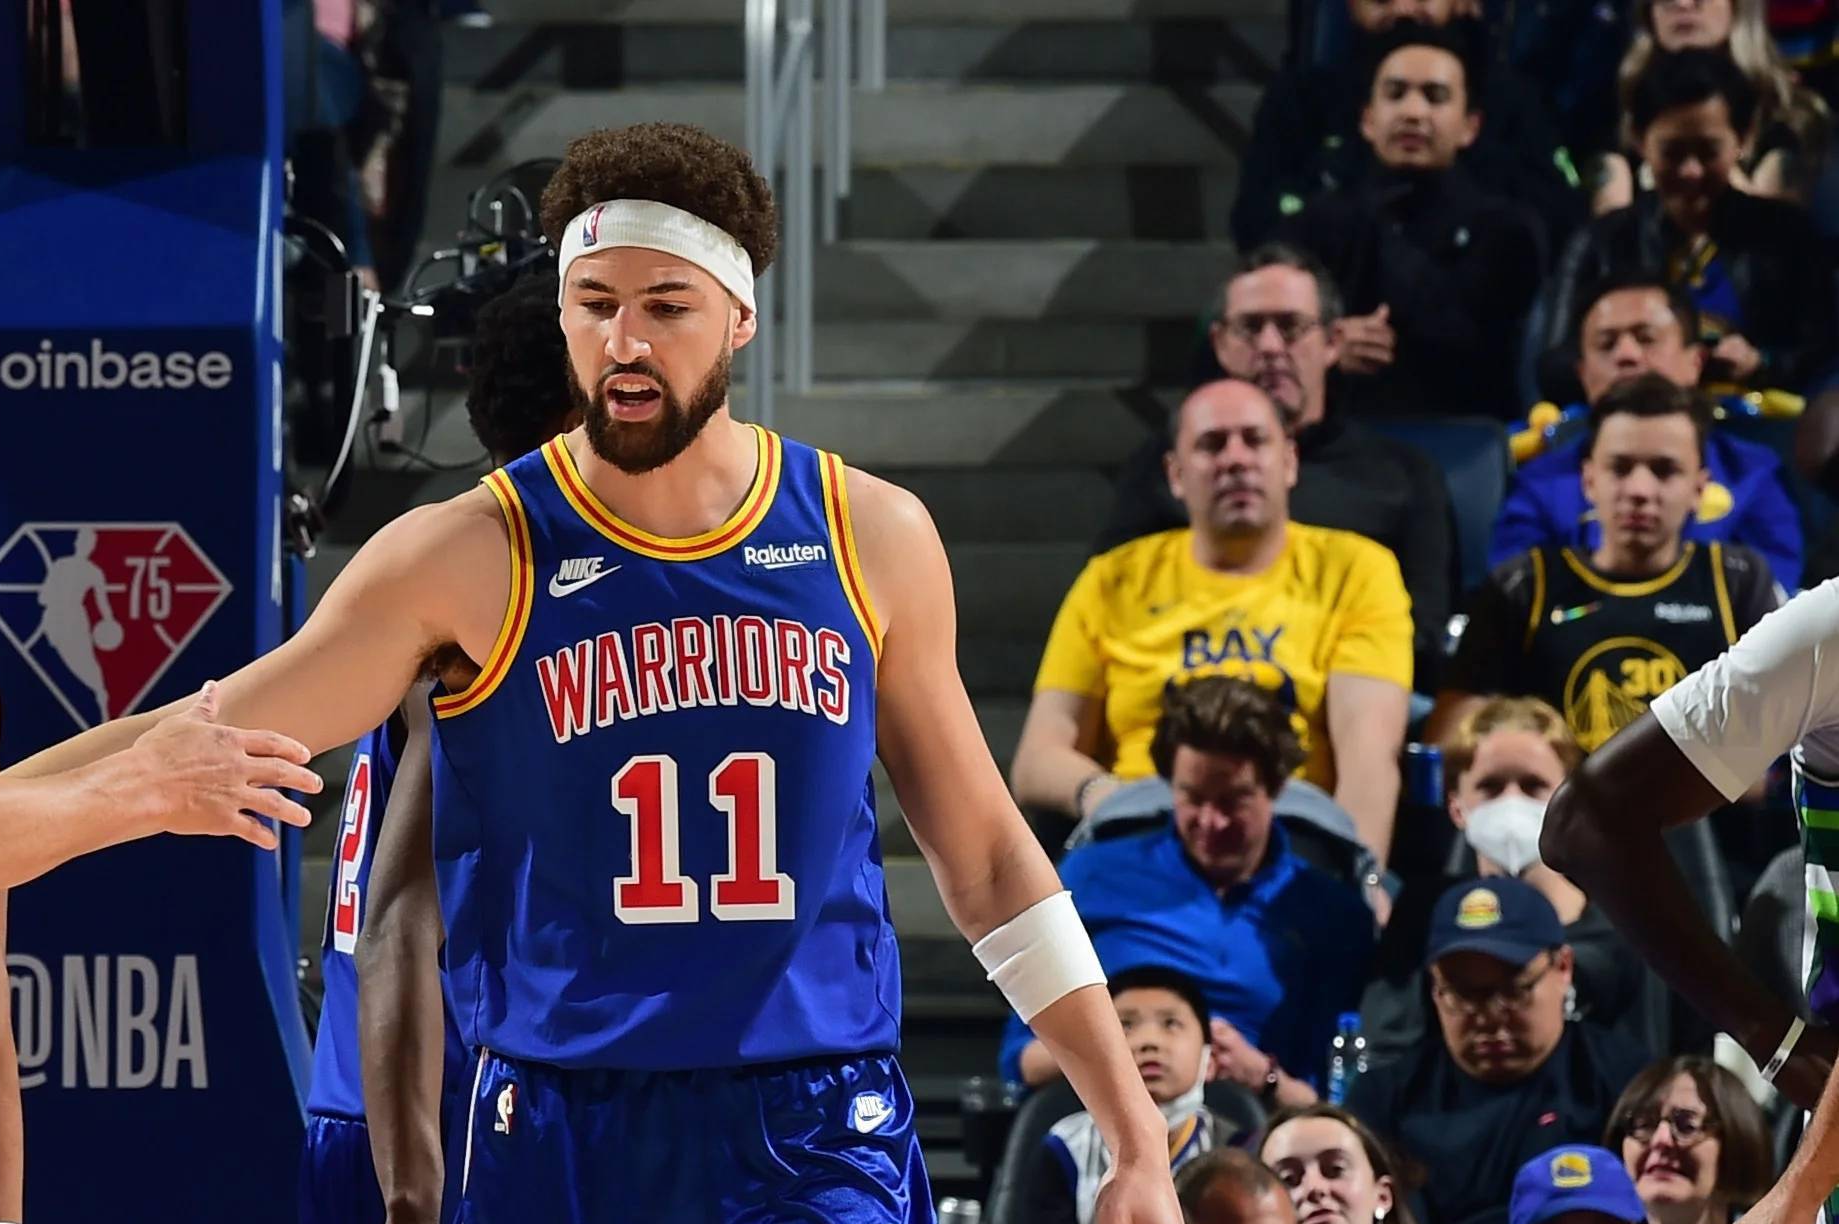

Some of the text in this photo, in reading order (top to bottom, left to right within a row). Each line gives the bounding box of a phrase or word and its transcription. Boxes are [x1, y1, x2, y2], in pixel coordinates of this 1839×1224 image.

[558, 557, 604, 581] NIKE
[744, 543, 827, 566] Rakuten
[125, 557, 172, 620] 75
[1183, 626, 1284, 669] BAY
[536, 614, 851, 744] WARRIORS
[1620, 656, 1678, 699] 30
[611, 751, 795, 924] 11
[6, 954, 208, 1089] @NBA
